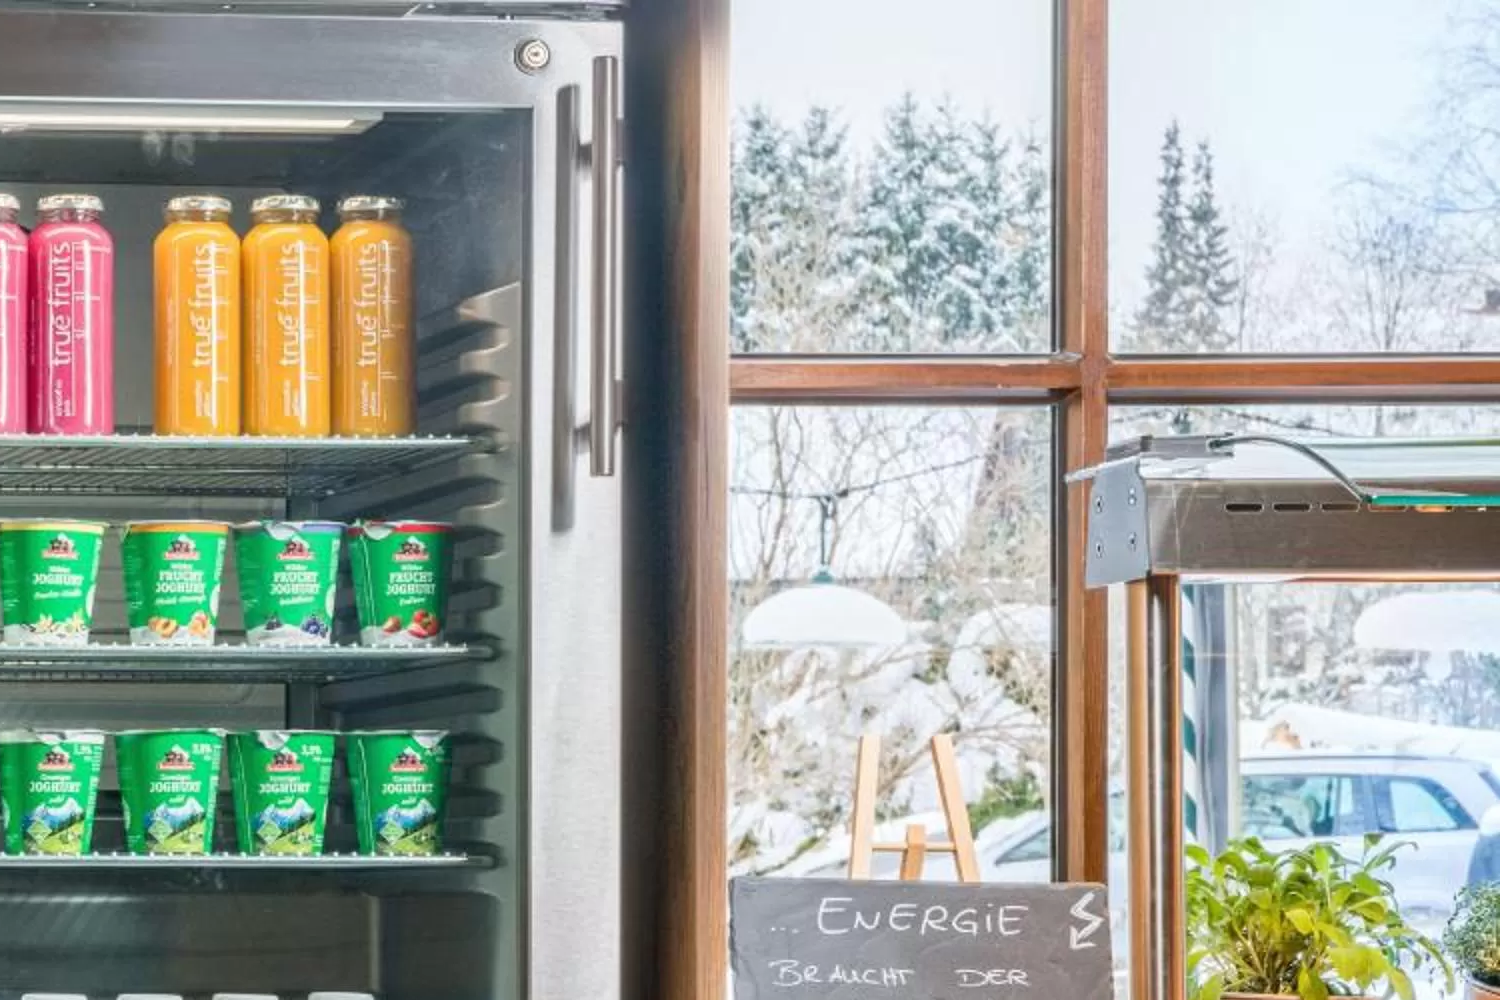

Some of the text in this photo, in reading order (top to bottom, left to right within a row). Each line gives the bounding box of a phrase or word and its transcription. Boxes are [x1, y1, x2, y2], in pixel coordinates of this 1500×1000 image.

[48, 241, 71, 366] true fruits
[188, 243, 212, 308] fruits
[276, 242, 300, 307] fruits
[354, 242, 377, 308] fruits
[190, 313, 212, 368] true
[278, 312, 299, 366] true
[356, 314, 377, 367] true
[954, 968, 1030, 988] DER
